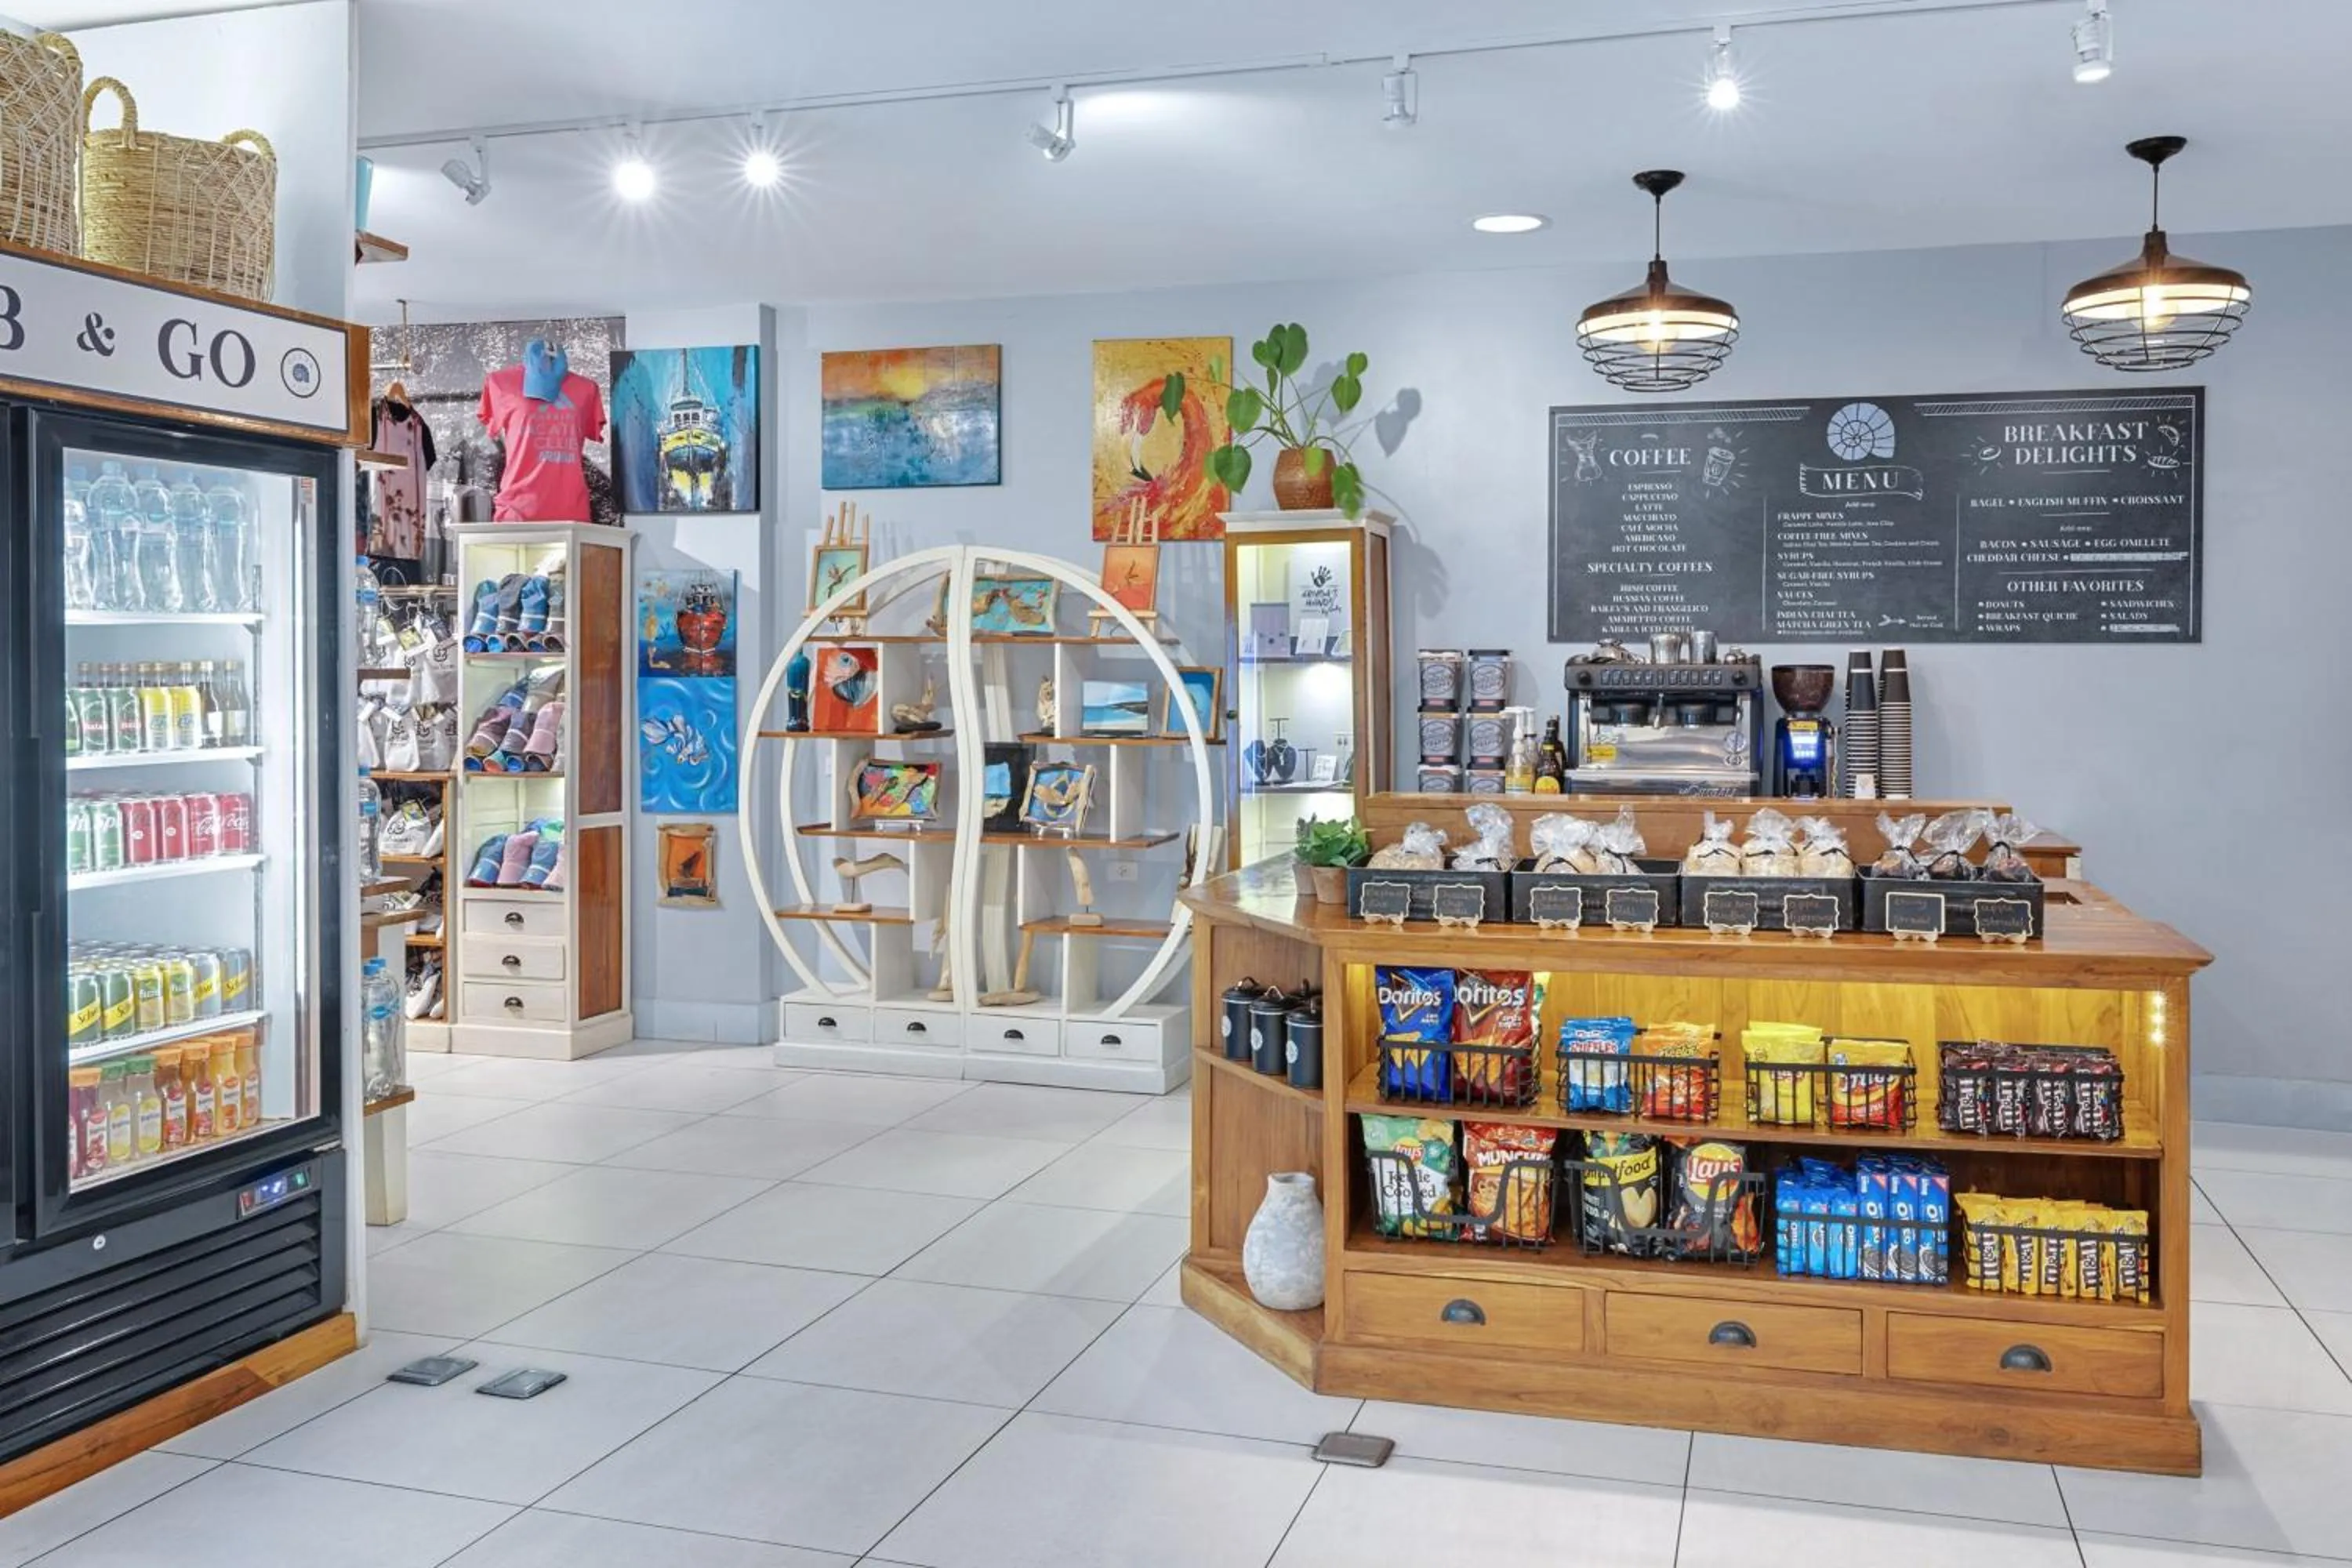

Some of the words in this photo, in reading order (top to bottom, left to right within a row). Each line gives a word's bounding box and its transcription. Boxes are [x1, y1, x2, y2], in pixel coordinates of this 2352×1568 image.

[77, 312, 115, 357] &
[158, 318, 256, 388] GO
[2004, 422, 2149, 443] BREAKFAST
[1610, 448, 1691, 466] COFFEE
[2016, 445, 2136, 465] DELIGHTS
[1823, 472, 1898, 490] MENU
[1628, 482, 1672, 491] ESPRESSO
[1622, 492, 1679, 501] CAPPUCCINO
[1970, 497, 2005, 507] BAGEL
[2018, 496, 2063, 506] ENGLISH
[2067, 495, 2108, 506] MUFFIN
[2121, 495, 2184, 505] CROISSANT
[1980, 540, 2016, 549] BACON
[2030, 539, 2081, 548] SAUSAGE
[2094, 539, 2117, 548] EGG
[1966, 554, 2018, 563] CHEDDAR
[2020, 553, 2061, 562] CHEESE
[1588, 562, 1652, 573] SPECIALTY
[1658, 561, 1713, 572] COFFEES
[2007, 580, 2058, 592] OTHER
[2063, 579, 2144, 591] FAVORITES
[1613, 594, 1650, 603] RUSSIAN
[1653, 604, 1708, 613] FRANGELICO
[2110, 600, 2175, 608] SANDWICHES
[1608, 615, 1657, 623] AMARETTO
[1659, 615, 1692, 623] COFFEE
[1985, 612, 2039, 621] BREAKFAST
[2042, 612, 2078, 622] QUICHE
[2110, 612, 2148, 621] SALADS
[1985, 624, 2021, 633] WRAPS
[1378, 986, 1442, 1007] Doritos
[1383, 1184, 1436, 1198] Cooed
